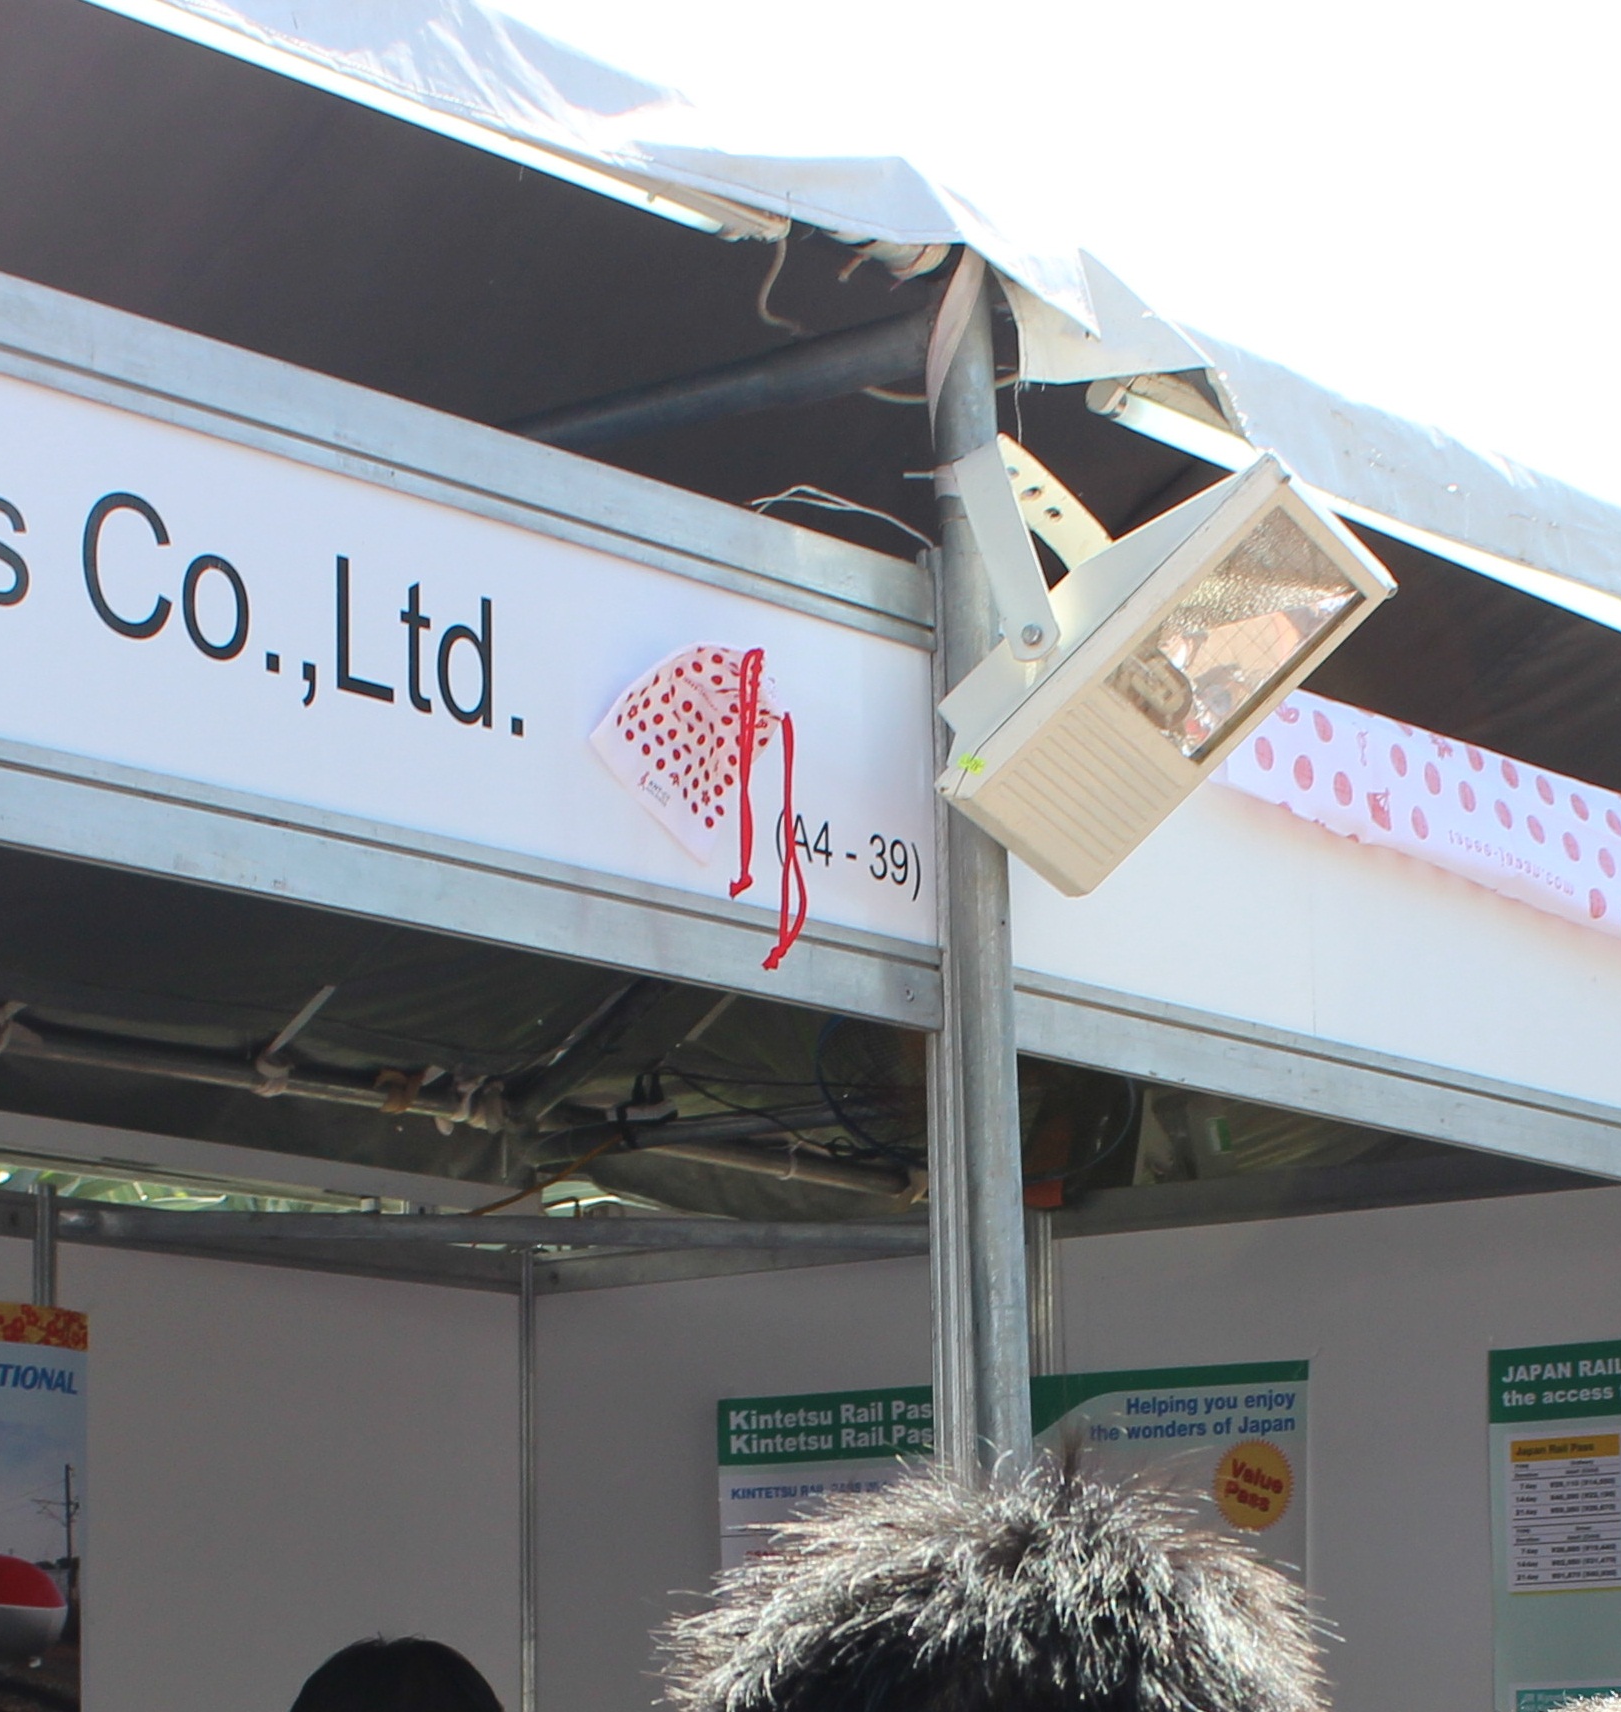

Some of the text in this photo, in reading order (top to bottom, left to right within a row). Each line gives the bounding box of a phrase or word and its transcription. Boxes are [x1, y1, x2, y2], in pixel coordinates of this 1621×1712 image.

[81, 491, 524, 738] Co.,Ltd.
[869, 833, 922, 901] 39)
[1502, 1362, 1572, 1383] JAPAN
[1127, 1389, 1296, 1417] Helping you enjoy
[1502, 1389, 1536, 1408] the
[1542, 1383, 1614, 1404] access
[730, 1400, 933, 1431] Kintetsu Rail Pas
[1089, 1416, 1296, 1441] the wonders of Japan
[730, 1424, 934, 1454] Kintetsu Rail Pas
[1515, 1442, 1595, 1457] Japan Rail Pass
[1231, 1458, 1283, 1495] Value
[731, 1485, 798, 1500] KINTETSU
[1224, 1481, 1270, 1512] Pass
